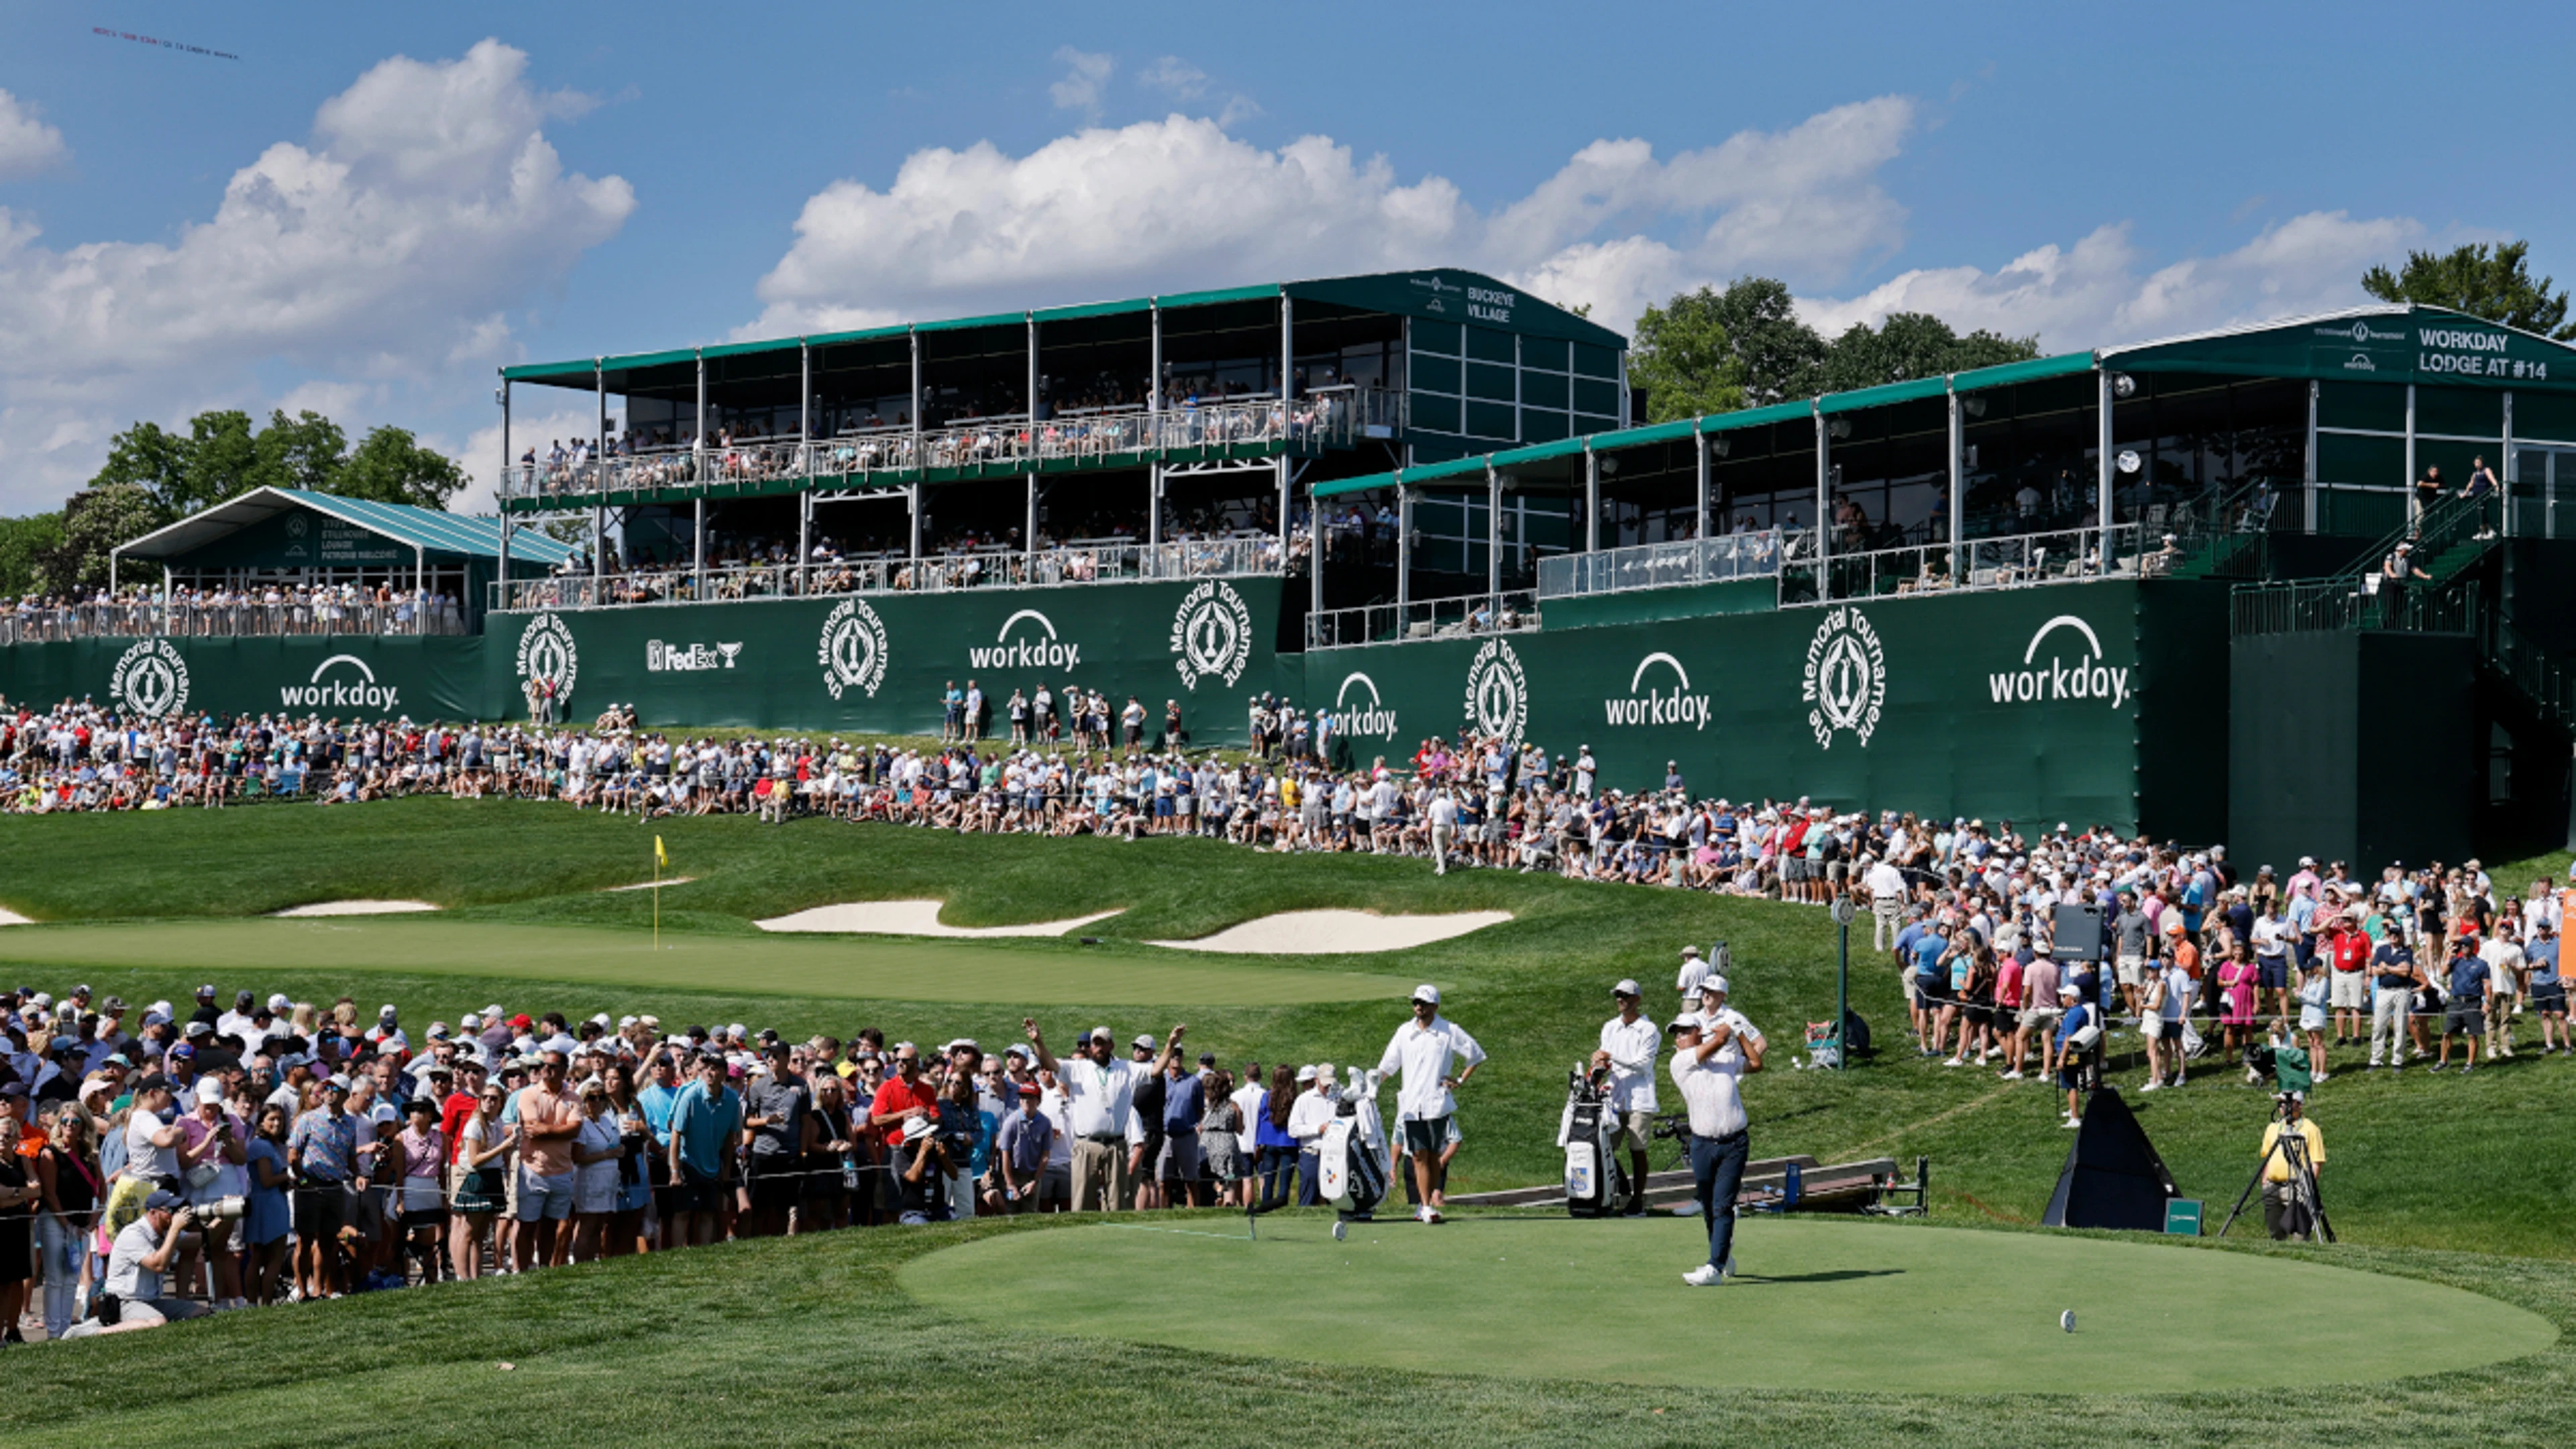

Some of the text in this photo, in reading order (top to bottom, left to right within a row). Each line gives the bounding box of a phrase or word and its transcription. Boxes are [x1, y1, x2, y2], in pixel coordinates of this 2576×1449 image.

[1468, 286, 1515, 308] BUCKEYE
[1468, 303, 1510, 323] VILLAGE
[2419, 328, 2508, 353] WORKDAY
[2419, 352, 2546, 380] LODGE AT #14
[516, 612, 548, 676] Memorial
[550, 614, 578, 706] Tournament
[665, 643, 718, 671] FedEx
[818, 596, 888, 700] the Memorial Tournament
[1170, 580, 1252, 692] the Memorial Tournament
[109, 637, 154, 698] Memorial
[1464, 637, 1497, 720] Memorial
[1803, 604, 1886, 750] the Memorial Tournament
